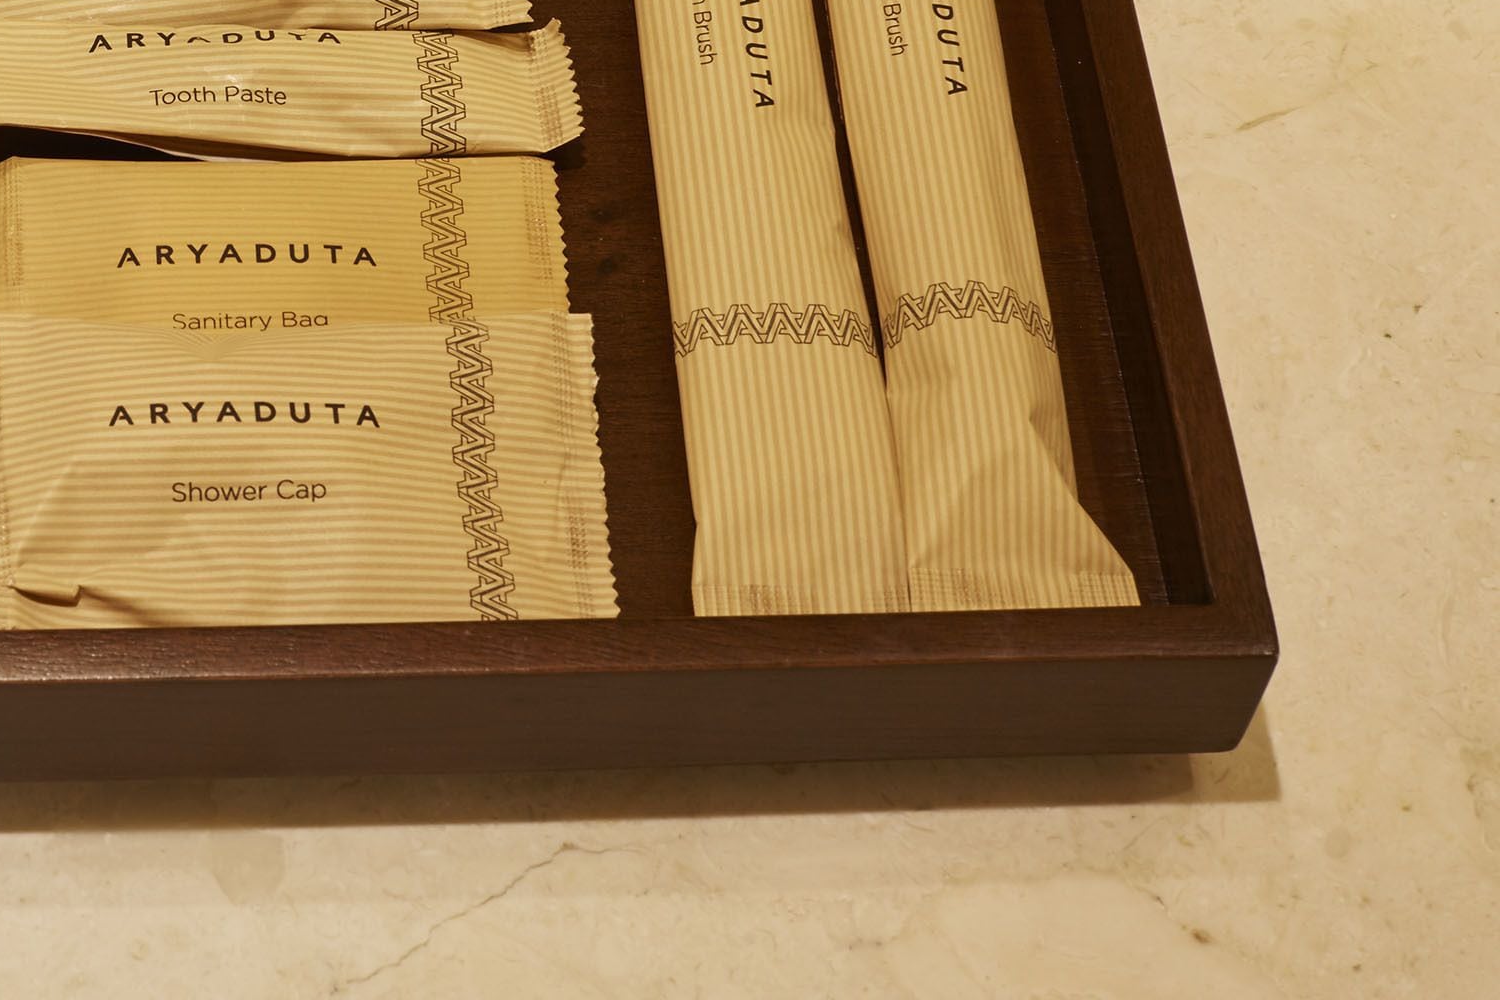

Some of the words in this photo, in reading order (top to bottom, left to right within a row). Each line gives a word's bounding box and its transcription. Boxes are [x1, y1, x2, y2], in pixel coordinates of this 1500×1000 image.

[693, 10, 718, 66] Brush
[882, 3, 909, 57] Brush
[149, 86, 216, 106] Tooth
[225, 85, 287, 106] Paste
[116, 243, 377, 269] ARYADUTA
[172, 313, 272, 332] Sanitary
[109, 401, 381, 429] ARYADUTA
[171, 481, 268, 503] Shower
[276, 479, 327, 503] Cap
